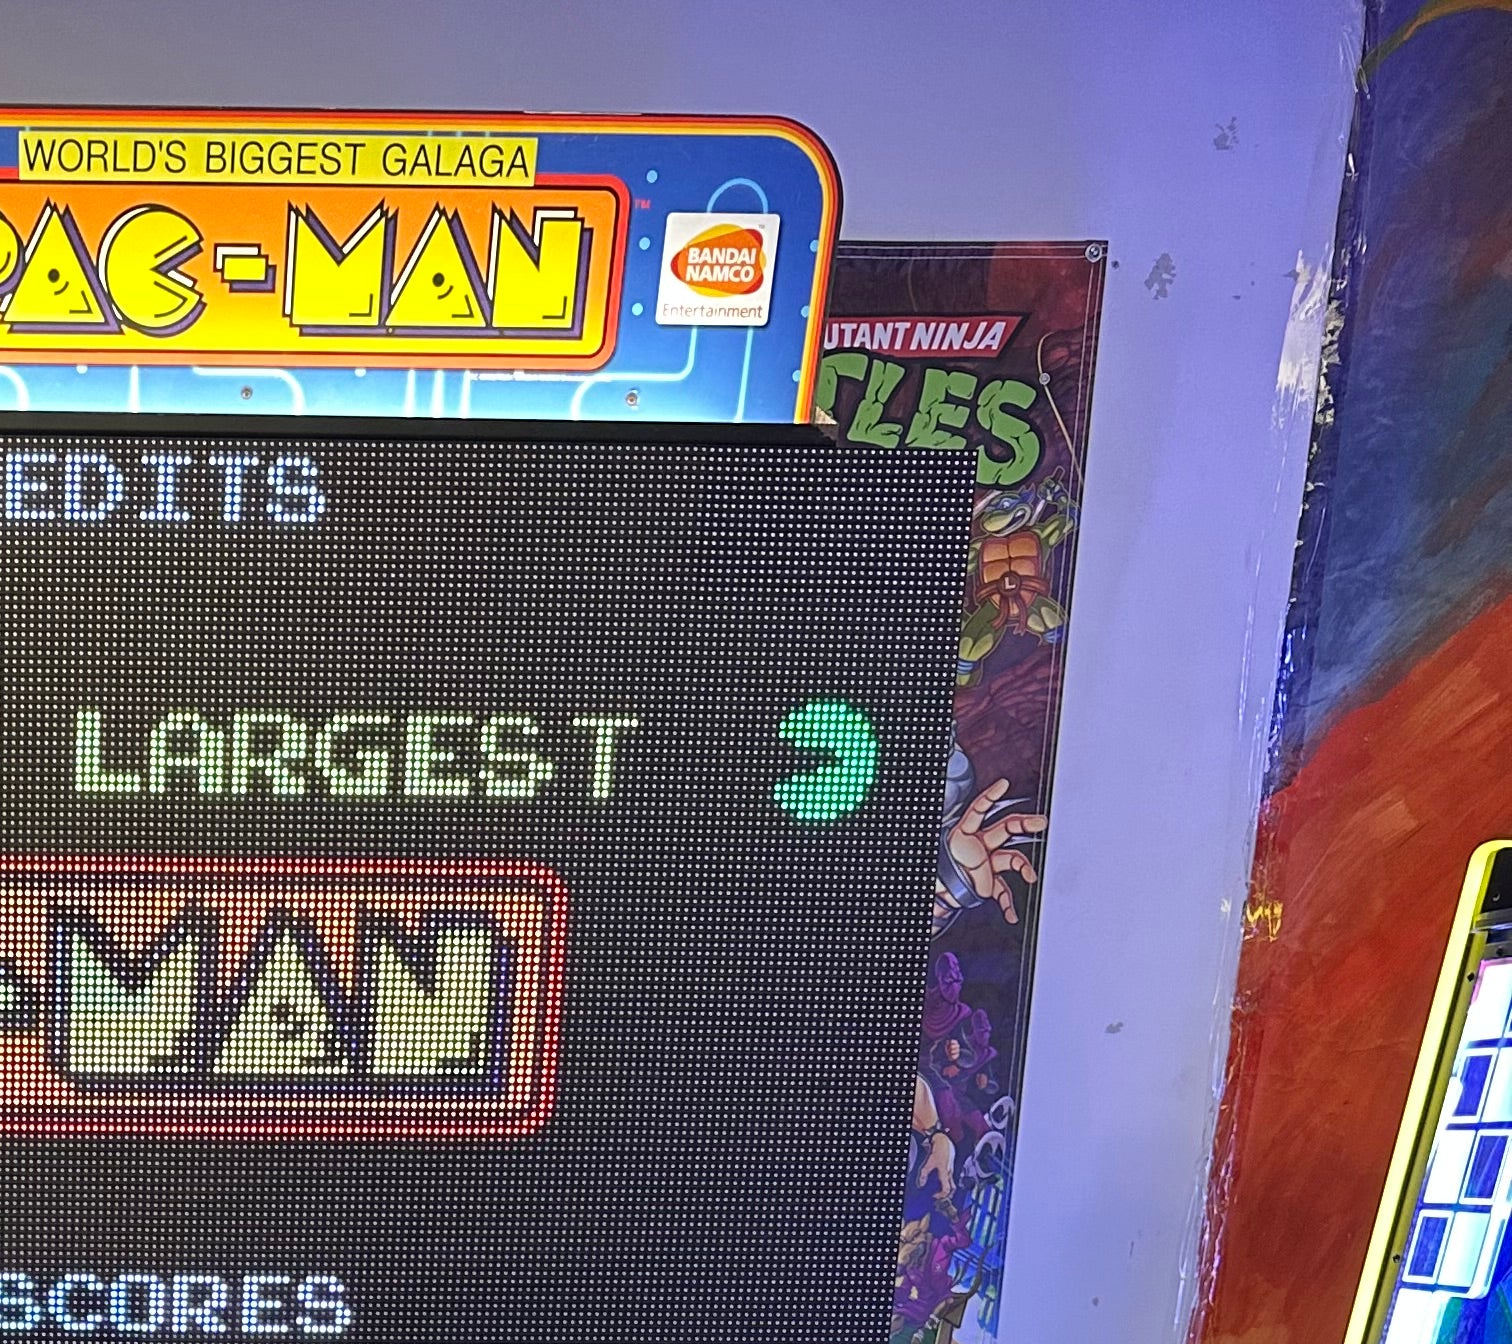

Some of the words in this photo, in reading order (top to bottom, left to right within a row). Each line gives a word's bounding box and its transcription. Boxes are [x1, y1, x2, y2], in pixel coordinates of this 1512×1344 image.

[24, 138, 187, 175] WORLD'S
[206, 140, 362, 177] BIGGEST
[386, 143, 530, 180] GALAGA
[688, 247, 757, 264] BANDAI
[685, 265, 755, 282] NAMCO
[662, 304, 763, 319] Entertainment
[823, 321, 911, 350] UTANT
[910, 321, 1006, 351] NINJA
[814, 353, 1040, 486] TLES
[74, 711, 639, 801] LARGEST
